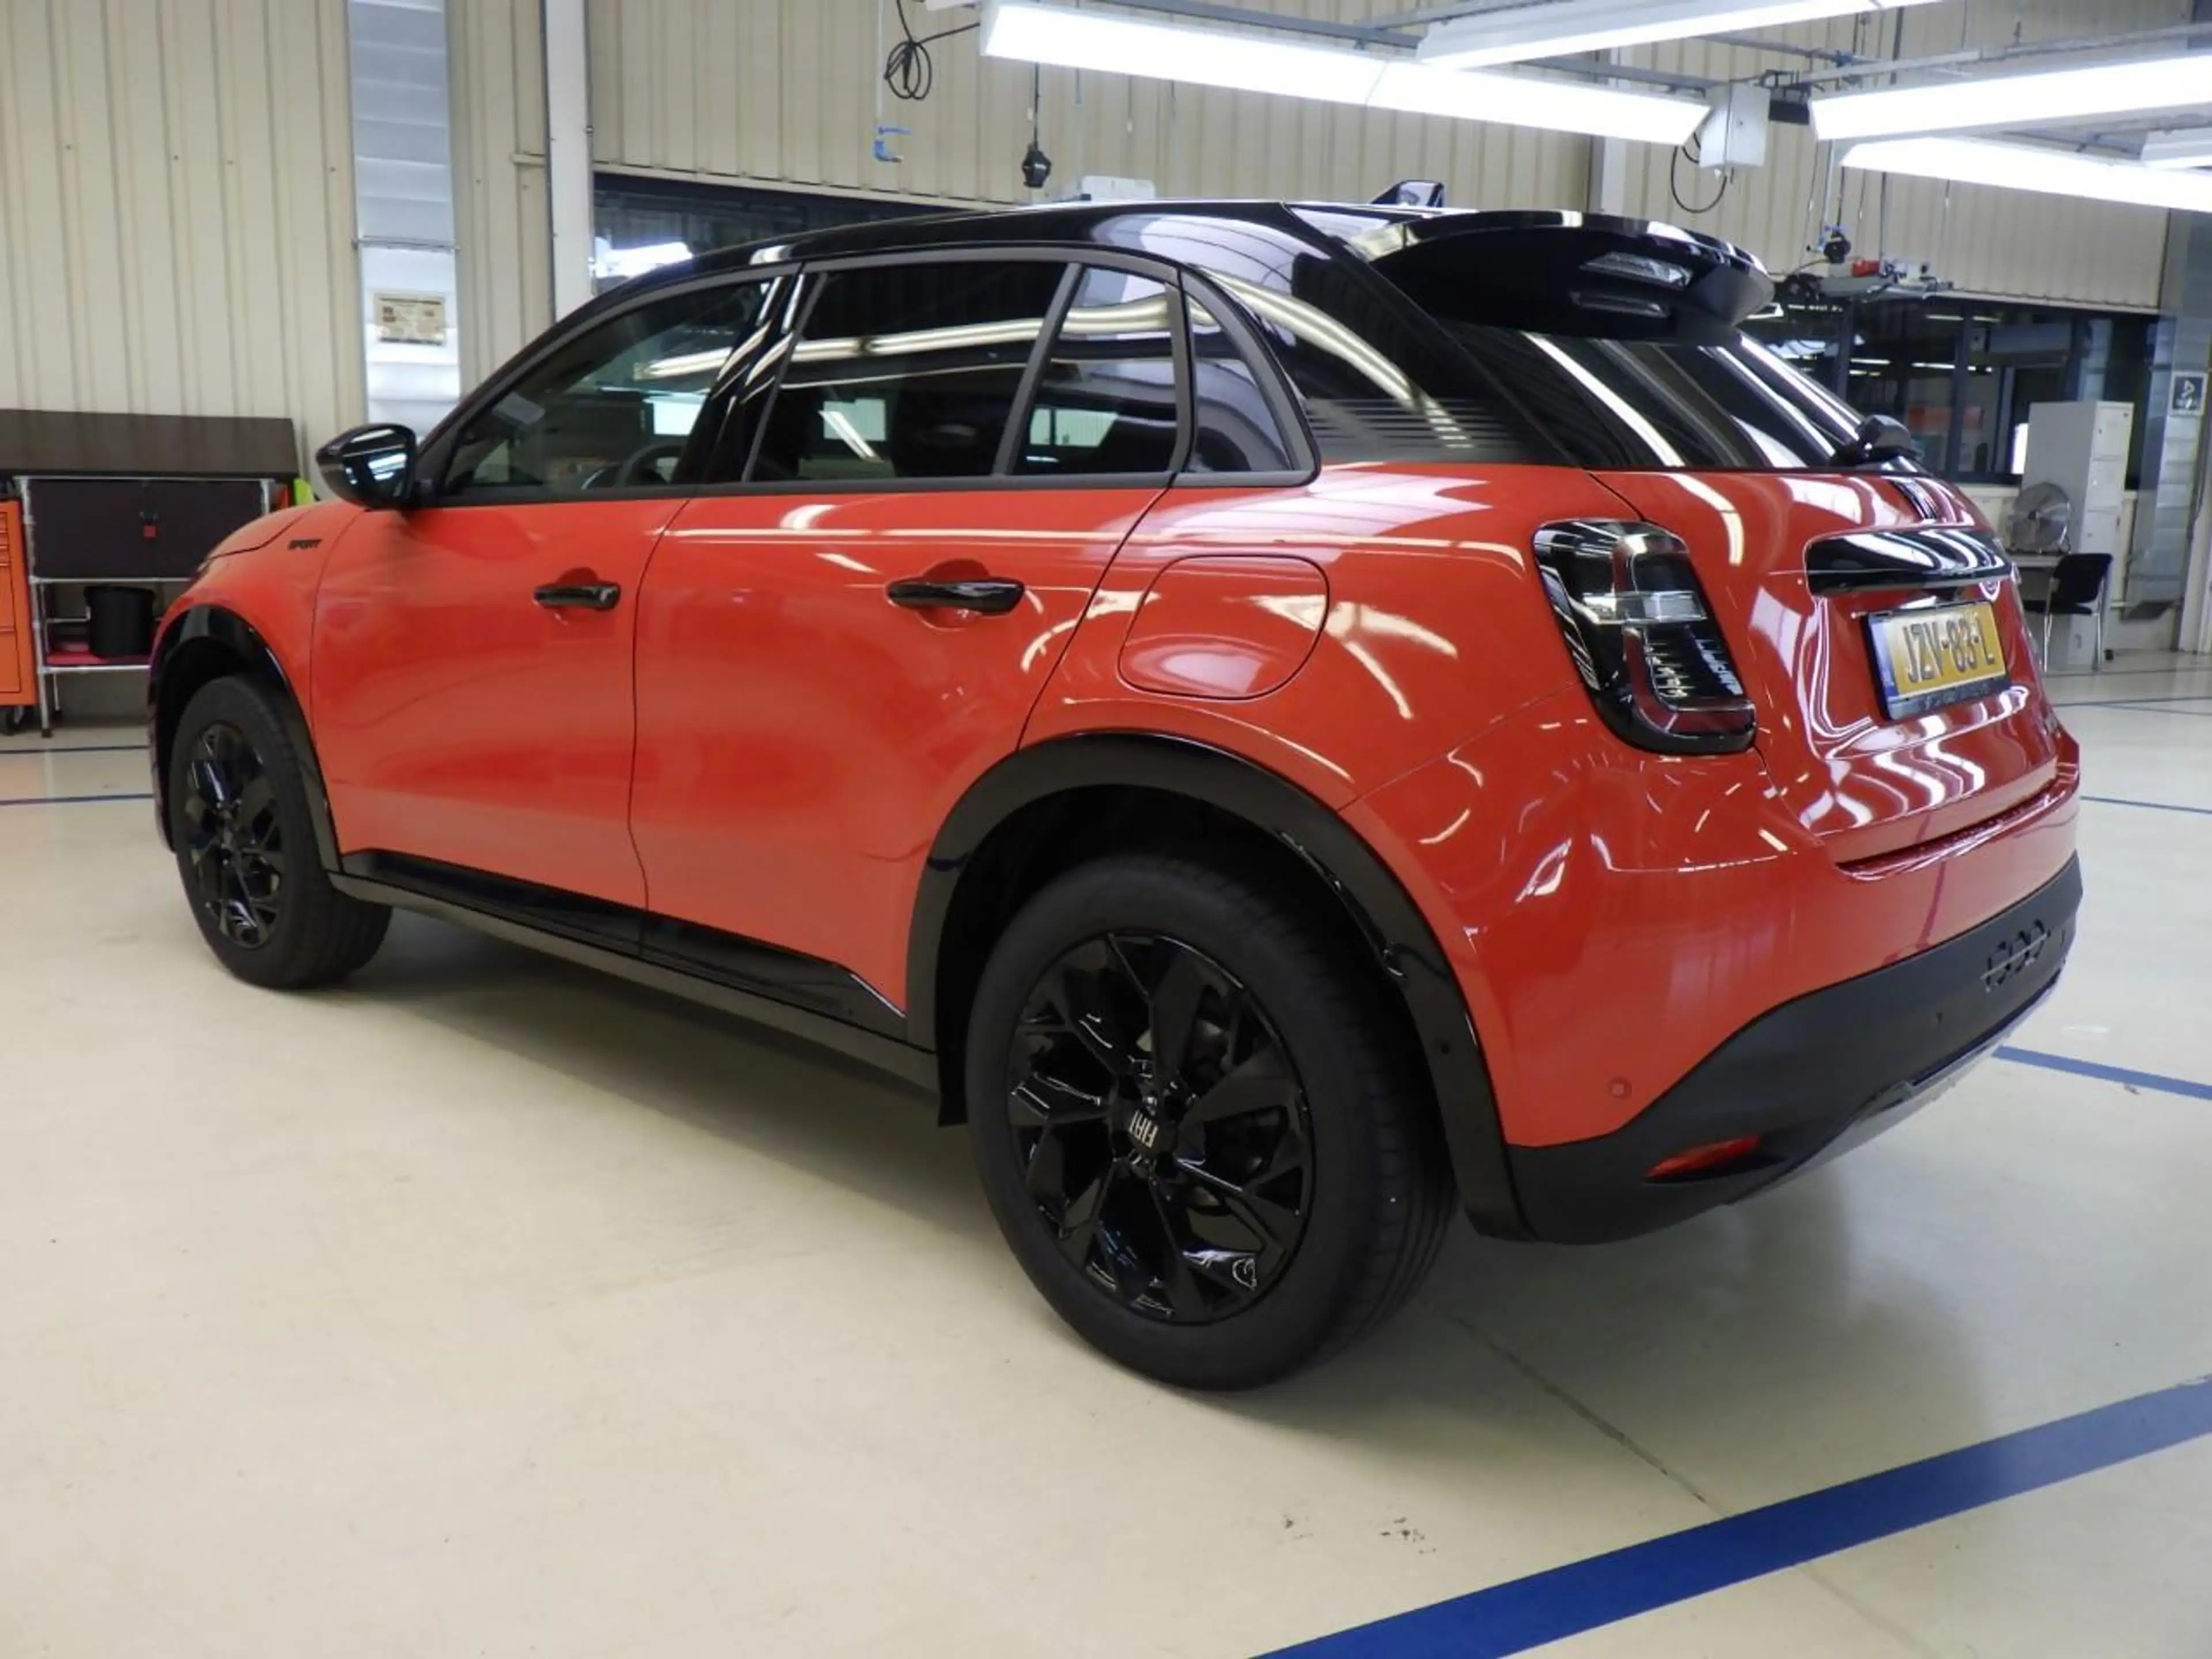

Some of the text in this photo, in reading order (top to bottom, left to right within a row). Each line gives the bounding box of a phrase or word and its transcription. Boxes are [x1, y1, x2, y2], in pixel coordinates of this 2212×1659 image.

[288, 539, 323, 550] SPORT
[1903, 616, 1995, 683] JZV-83-L
[1128, 1109, 1158, 1149] FIAT
